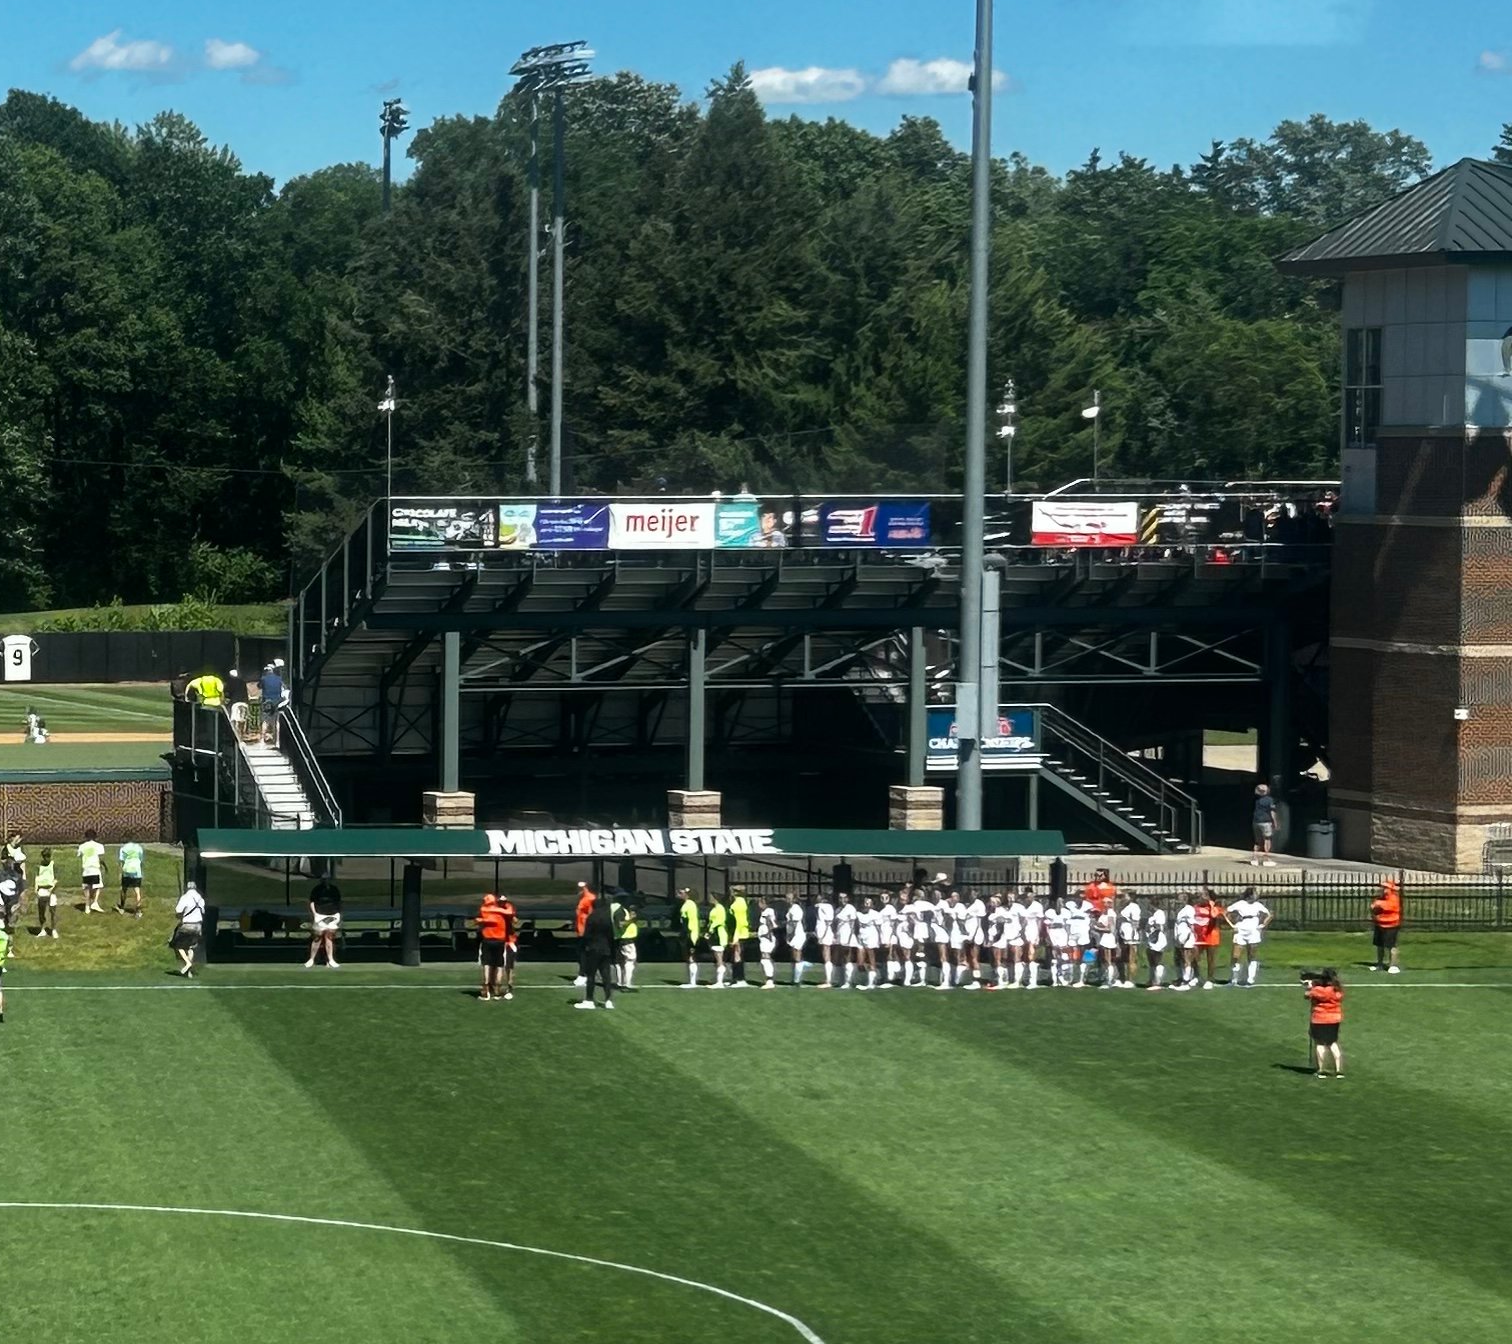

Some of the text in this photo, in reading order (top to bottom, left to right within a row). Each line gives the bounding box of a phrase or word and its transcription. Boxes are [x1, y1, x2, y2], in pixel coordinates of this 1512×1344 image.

[626, 508, 700, 538] meijer
[13, 649, 23, 666] 9
[486, 829, 779, 854] MICHIGAN STATE
